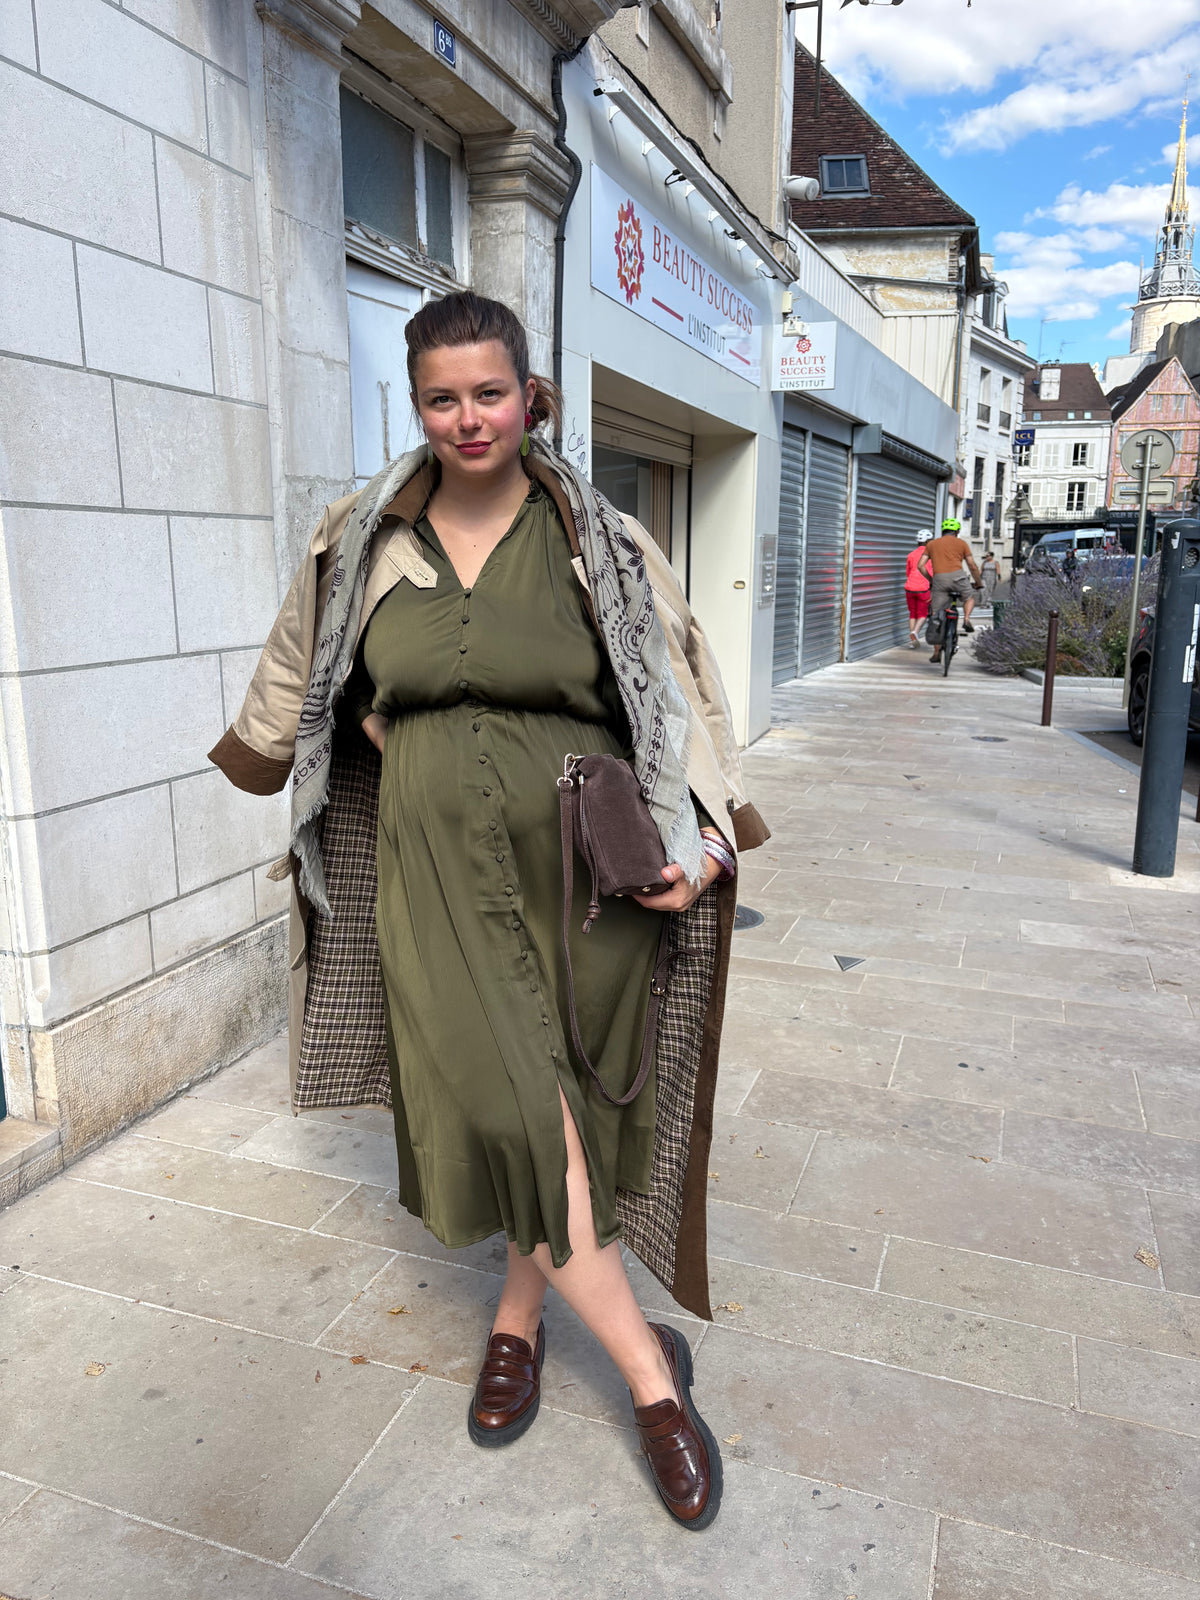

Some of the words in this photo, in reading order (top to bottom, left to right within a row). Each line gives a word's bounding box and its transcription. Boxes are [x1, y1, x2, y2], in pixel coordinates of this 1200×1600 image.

[653, 224, 706, 298] BEAUTY
[707, 273, 753, 335] SUCCESS
[688, 313, 726, 356] L'INSTITUT
[780, 355, 826, 366] BEAUTY
[780, 366, 826, 376] SUCCESS
[779, 379, 825, 389] L'INSTITUT
[1015, 432, 1033, 440] LCL
